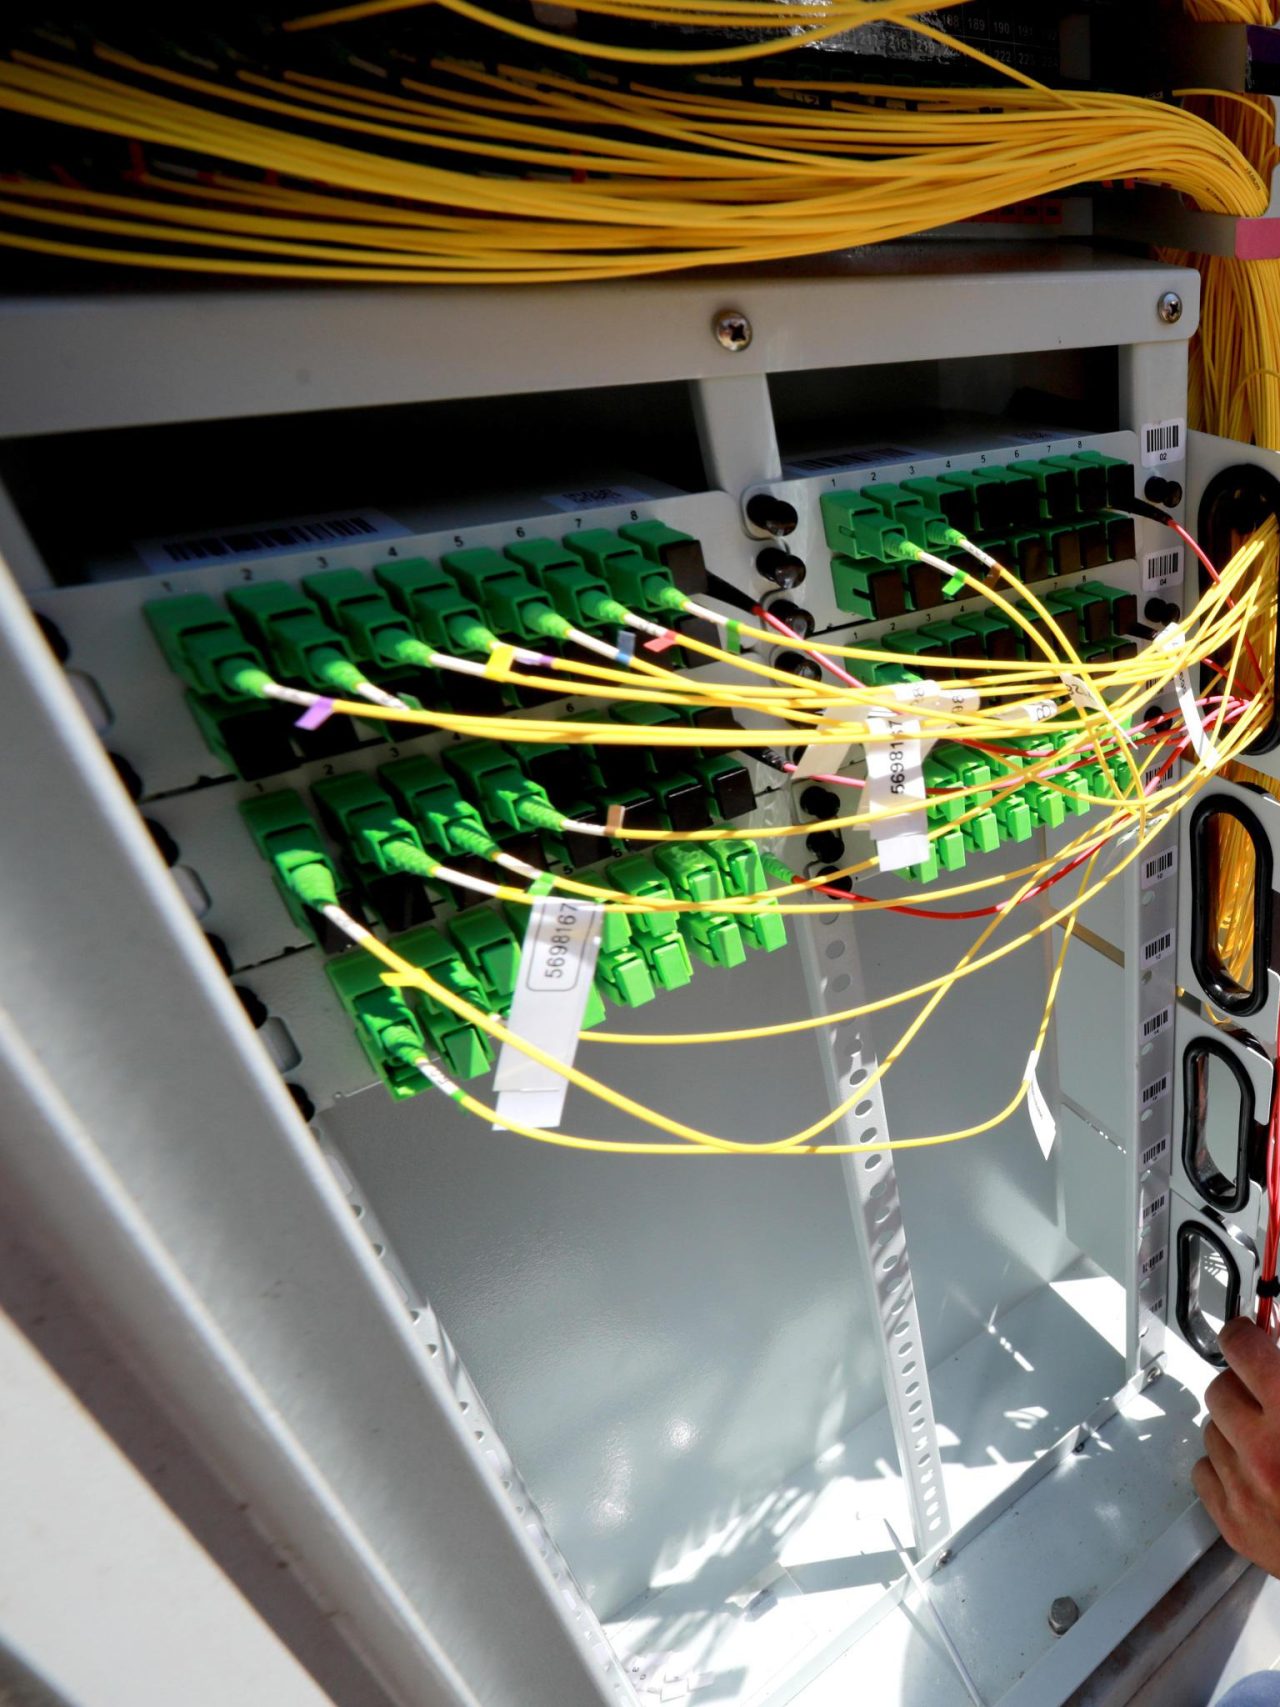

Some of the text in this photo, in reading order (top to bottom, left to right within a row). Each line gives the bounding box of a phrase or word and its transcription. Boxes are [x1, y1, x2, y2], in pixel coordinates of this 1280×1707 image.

[968, 17, 985, 32] 189
[994, 21, 1010, 35] 190
[871, 472, 876, 481] 2
[909, 465, 915, 475] 3
[946, 460, 951, 468] 4
[981, 454, 986, 463] 5
[1014, 450, 1020, 458] 6
[241, 569, 252, 580] 2
[318, 557, 328, 568] 3
[388, 547, 397, 556] 4
[454, 536, 463, 546] 5
[516, 527, 525, 538] 6
[575, 518, 582, 528] 7
[630, 510, 639, 521] 8
[890, 622, 895, 631] 2
[926, 613, 931, 622] 3
[325, 764, 334, 776] 2
[390, 747, 400, 758] 3
[566, 703, 575, 713] 6
[563, 848, 622, 875] 5 6
[544, 903, 579, 979] 5698167
